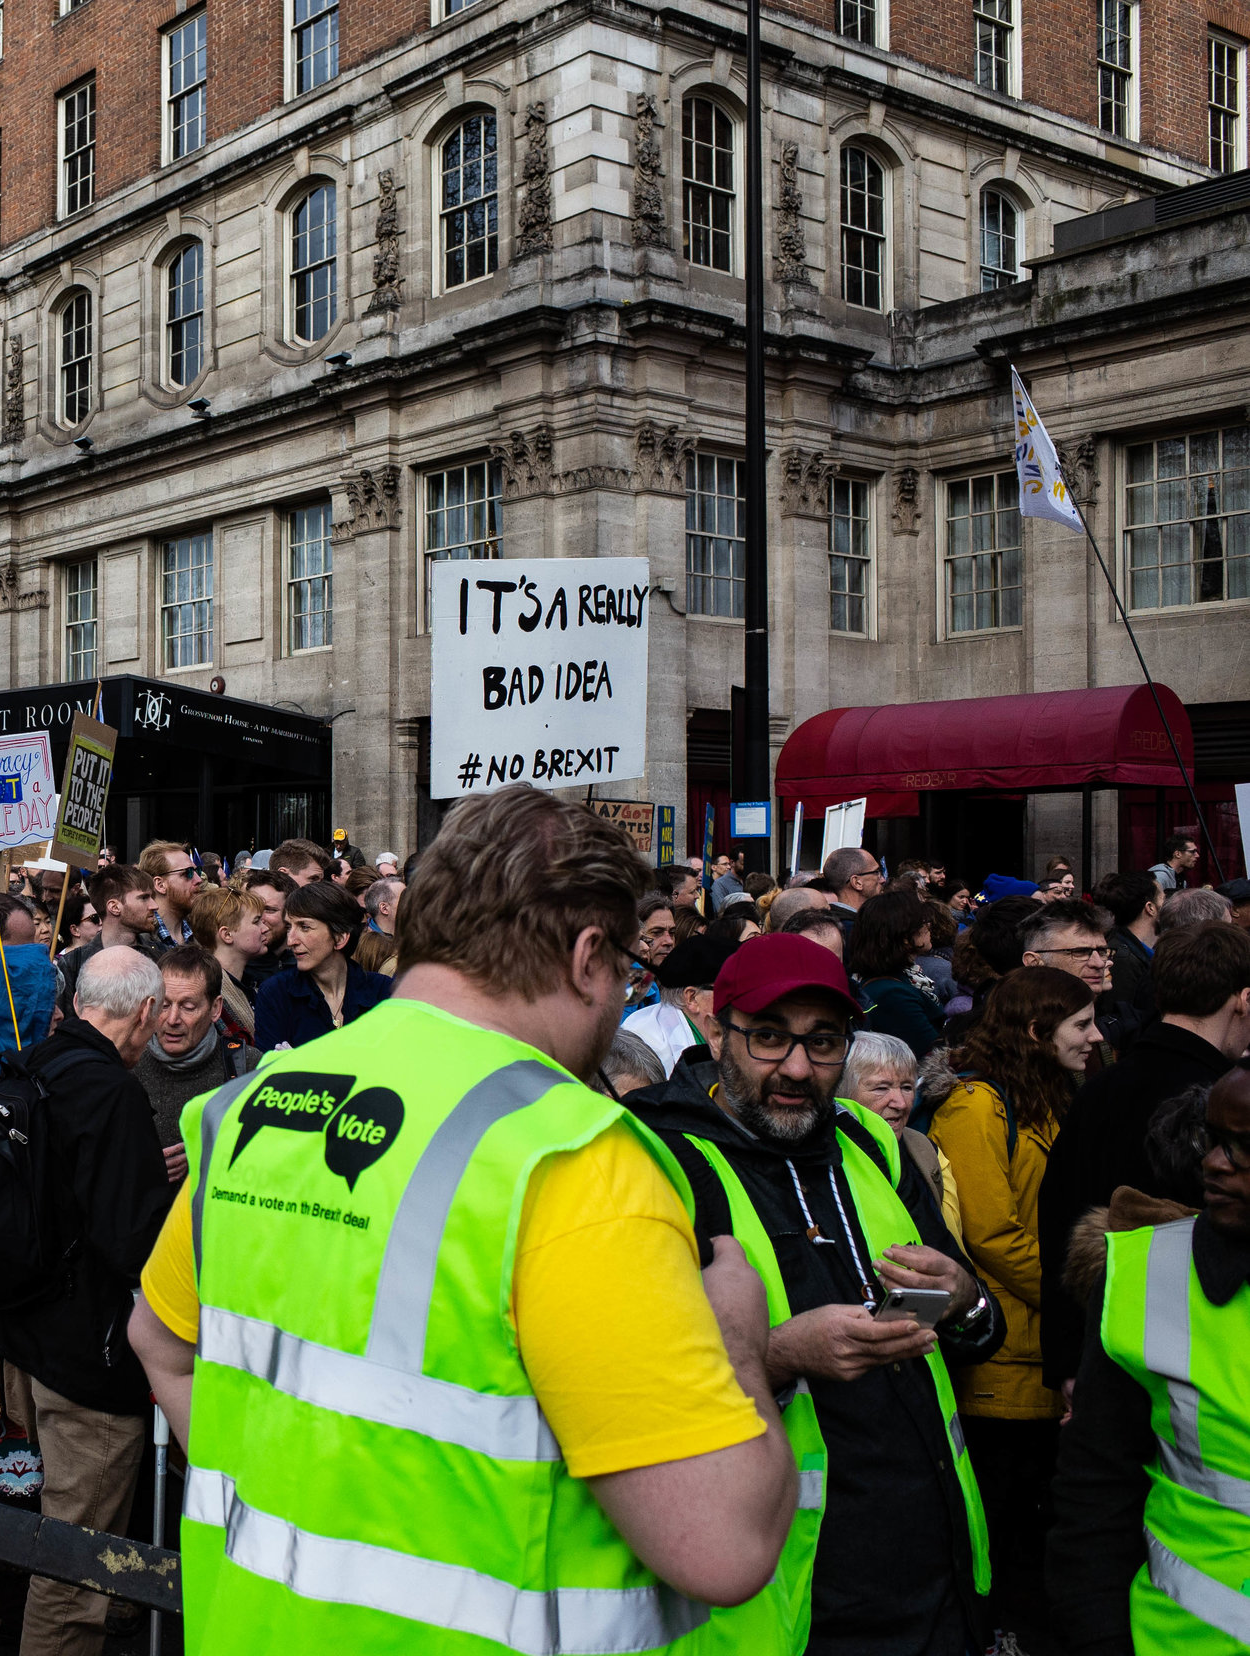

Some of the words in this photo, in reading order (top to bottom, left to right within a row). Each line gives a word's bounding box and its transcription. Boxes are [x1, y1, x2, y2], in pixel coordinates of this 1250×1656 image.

[459, 574, 543, 635] IT'S
[545, 586, 568, 631] A
[577, 584, 649, 628] REALLY
[483, 665, 545, 710] BAD
[555, 659, 613, 702] IDEA
[25, 698, 93, 729] ROOM
[72, 747, 98, 781] PUT
[97, 758, 110, 787] IT
[532, 746, 620, 782] BREXIT
[32, 781, 42, 793] a
[70, 775, 83, 803] TO
[85, 781, 105, 812] THE
[18, 794, 53, 833] DAY
[63, 800, 101, 835] PEOPLE
[612, 819, 650, 834] OTES
[252, 1086, 337, 1116] People's
[337, 1113, 387, 1145] Vote
[211, 1186, 248, 1205] Demand
[249, 1194, 256, 1206] a
[258, 1196, 285, 1211] vote
[286, 1201, 298, 1213] on
[311, 1203, 342, 1223] Brexit
[342, 1211, 371, 1230] deal
